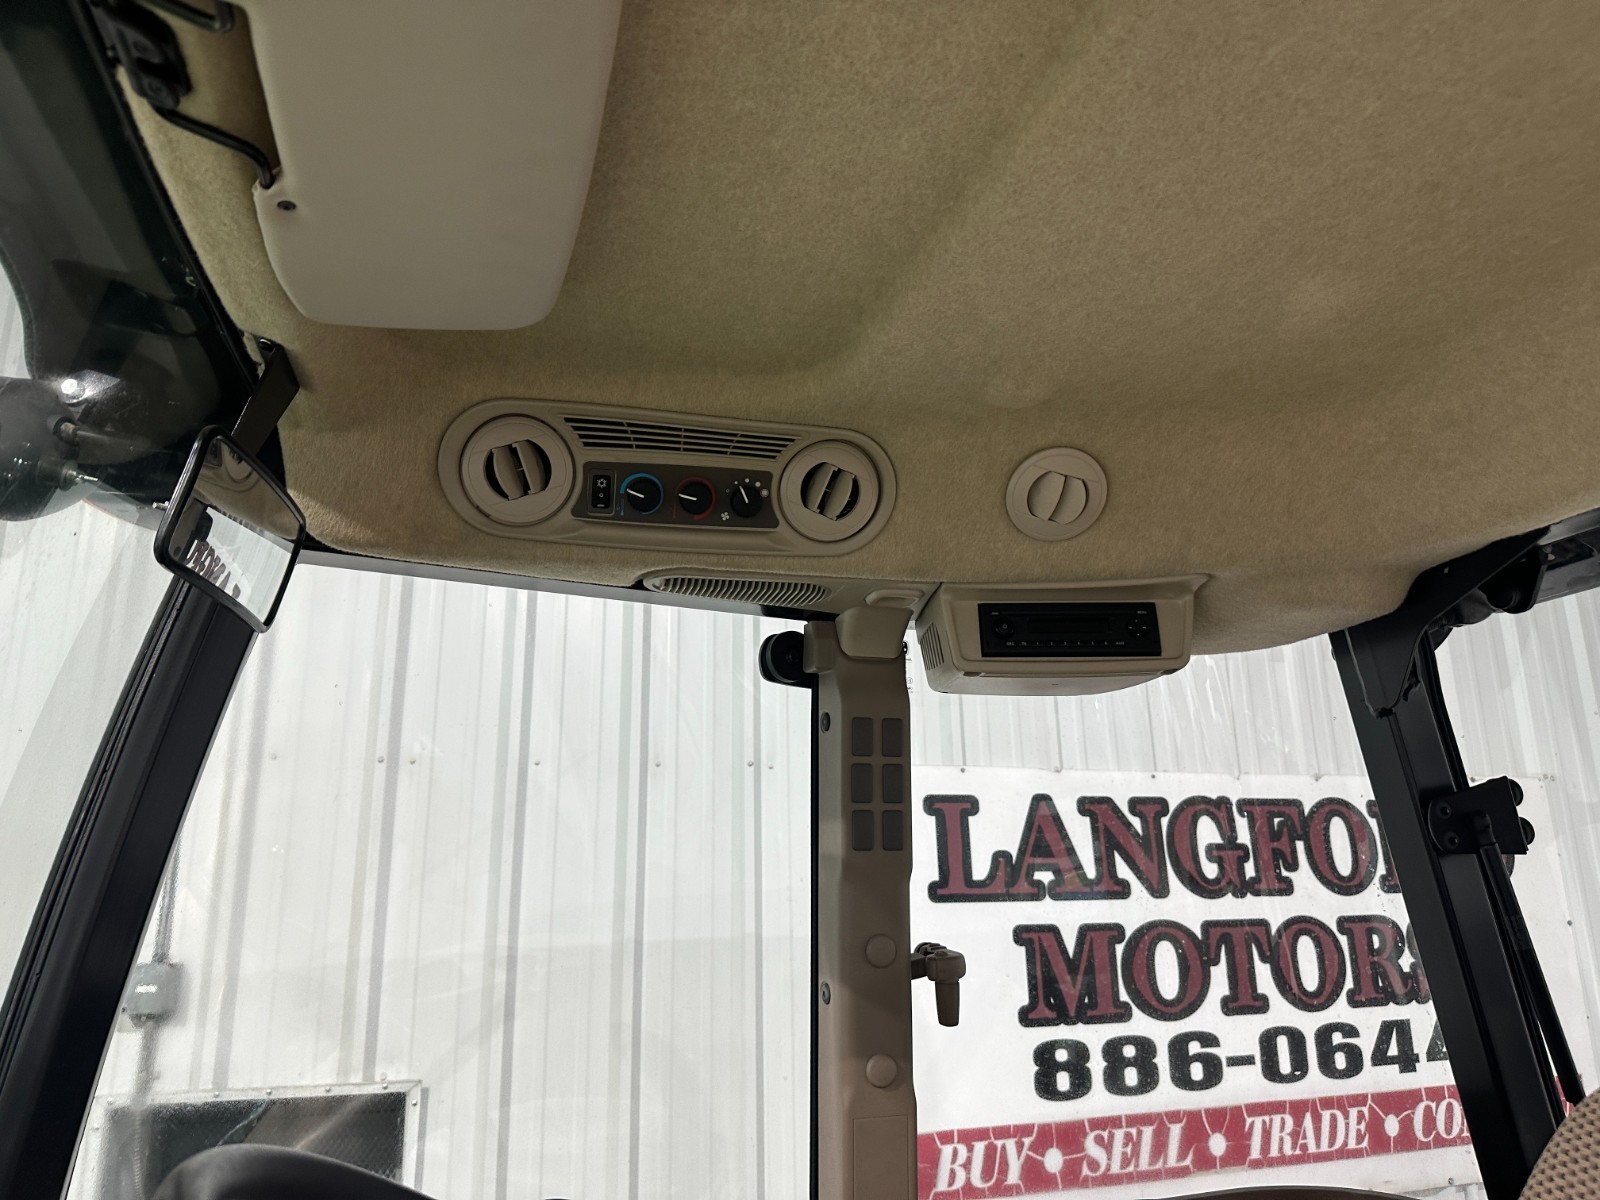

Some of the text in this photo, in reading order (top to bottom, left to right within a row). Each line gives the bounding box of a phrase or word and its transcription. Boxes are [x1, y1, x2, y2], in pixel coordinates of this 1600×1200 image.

[935, 1098, 1471, 1193] BUY SELL TRADE CO
